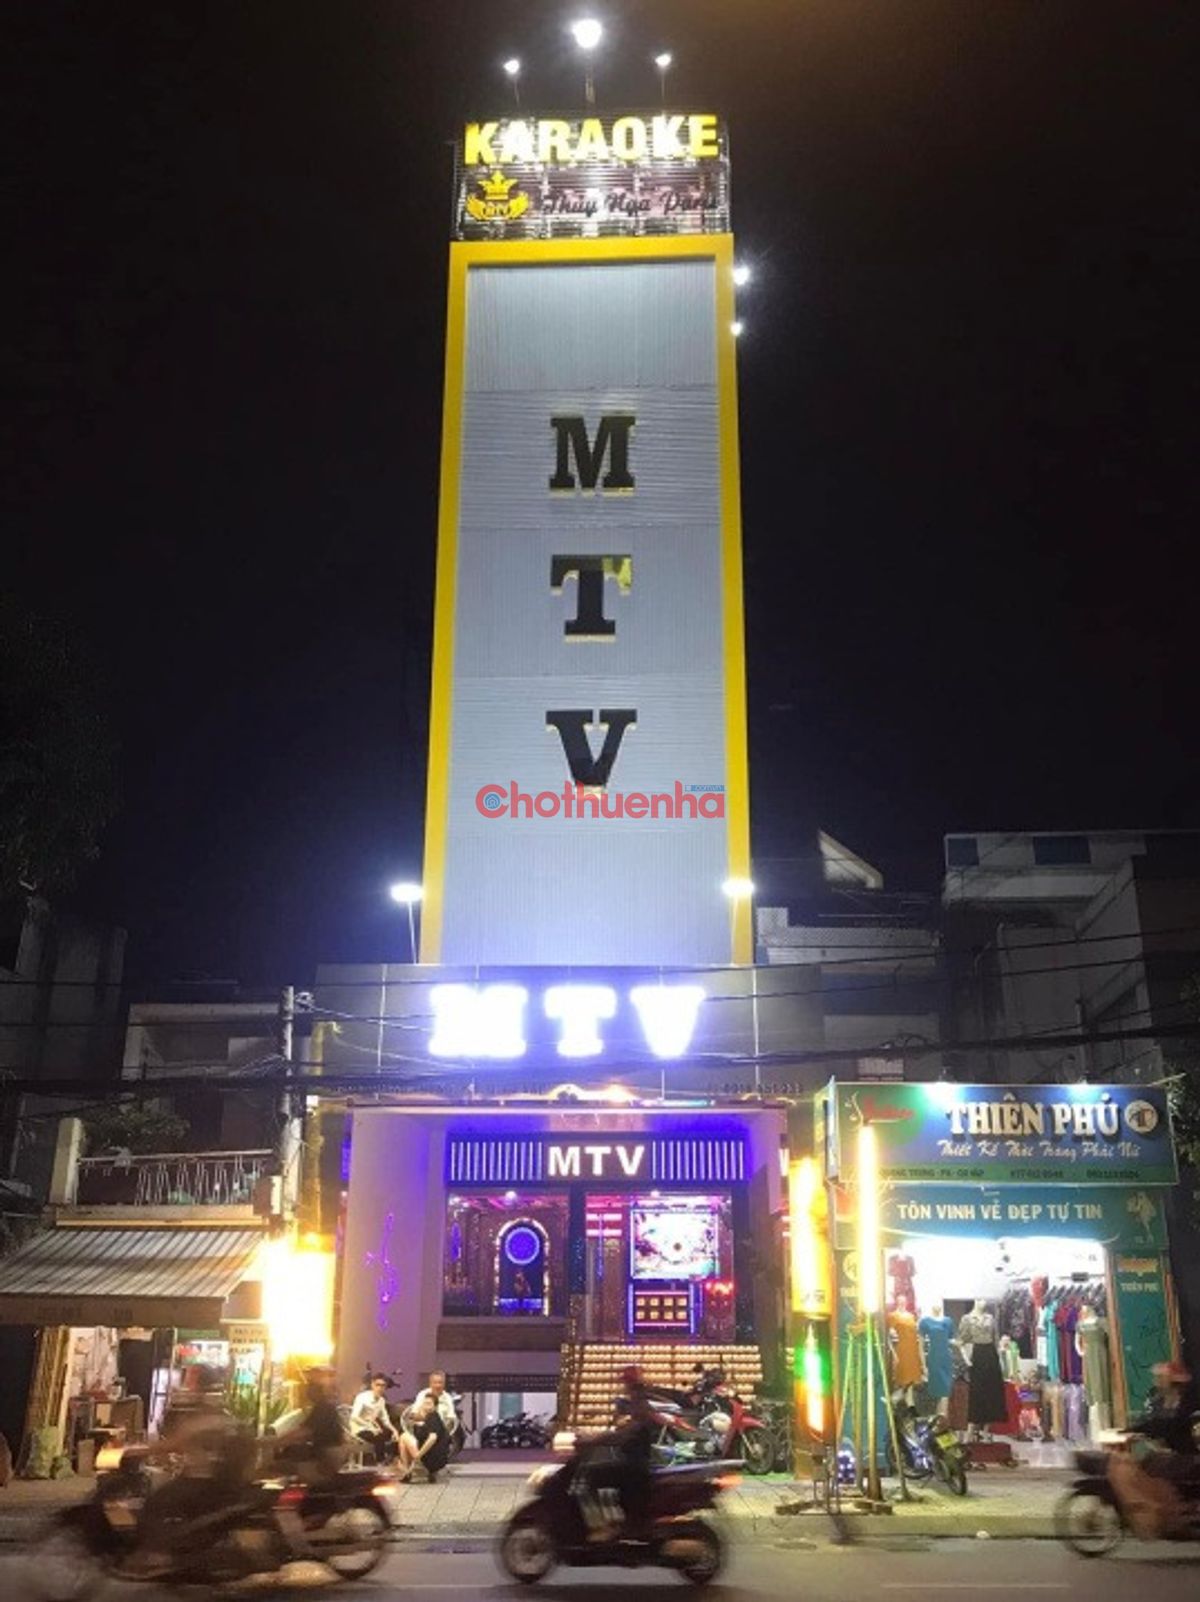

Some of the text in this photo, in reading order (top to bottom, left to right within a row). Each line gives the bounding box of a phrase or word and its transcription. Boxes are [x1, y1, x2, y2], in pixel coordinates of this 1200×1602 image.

[464, 114, 719, 164] KARAOKE
[605, 191, 651, 219] Nga
[428, 983, 706, 1058] MTV
[946, 1093, 1044, 1135] THIÊN
[547, 1145, 645, 1177] MTV
[1039, 1141, 1077, 1163] Trang
[897, 1200, 932, 1220] TÔN
[936, 1204, 976, 1220] VINH
[1008, 1204, 1042, 1223] ĐẸP
[1047, 1202, 1070, 1223] TỰ
[1074, 1204, 1102, 1220] TIN
